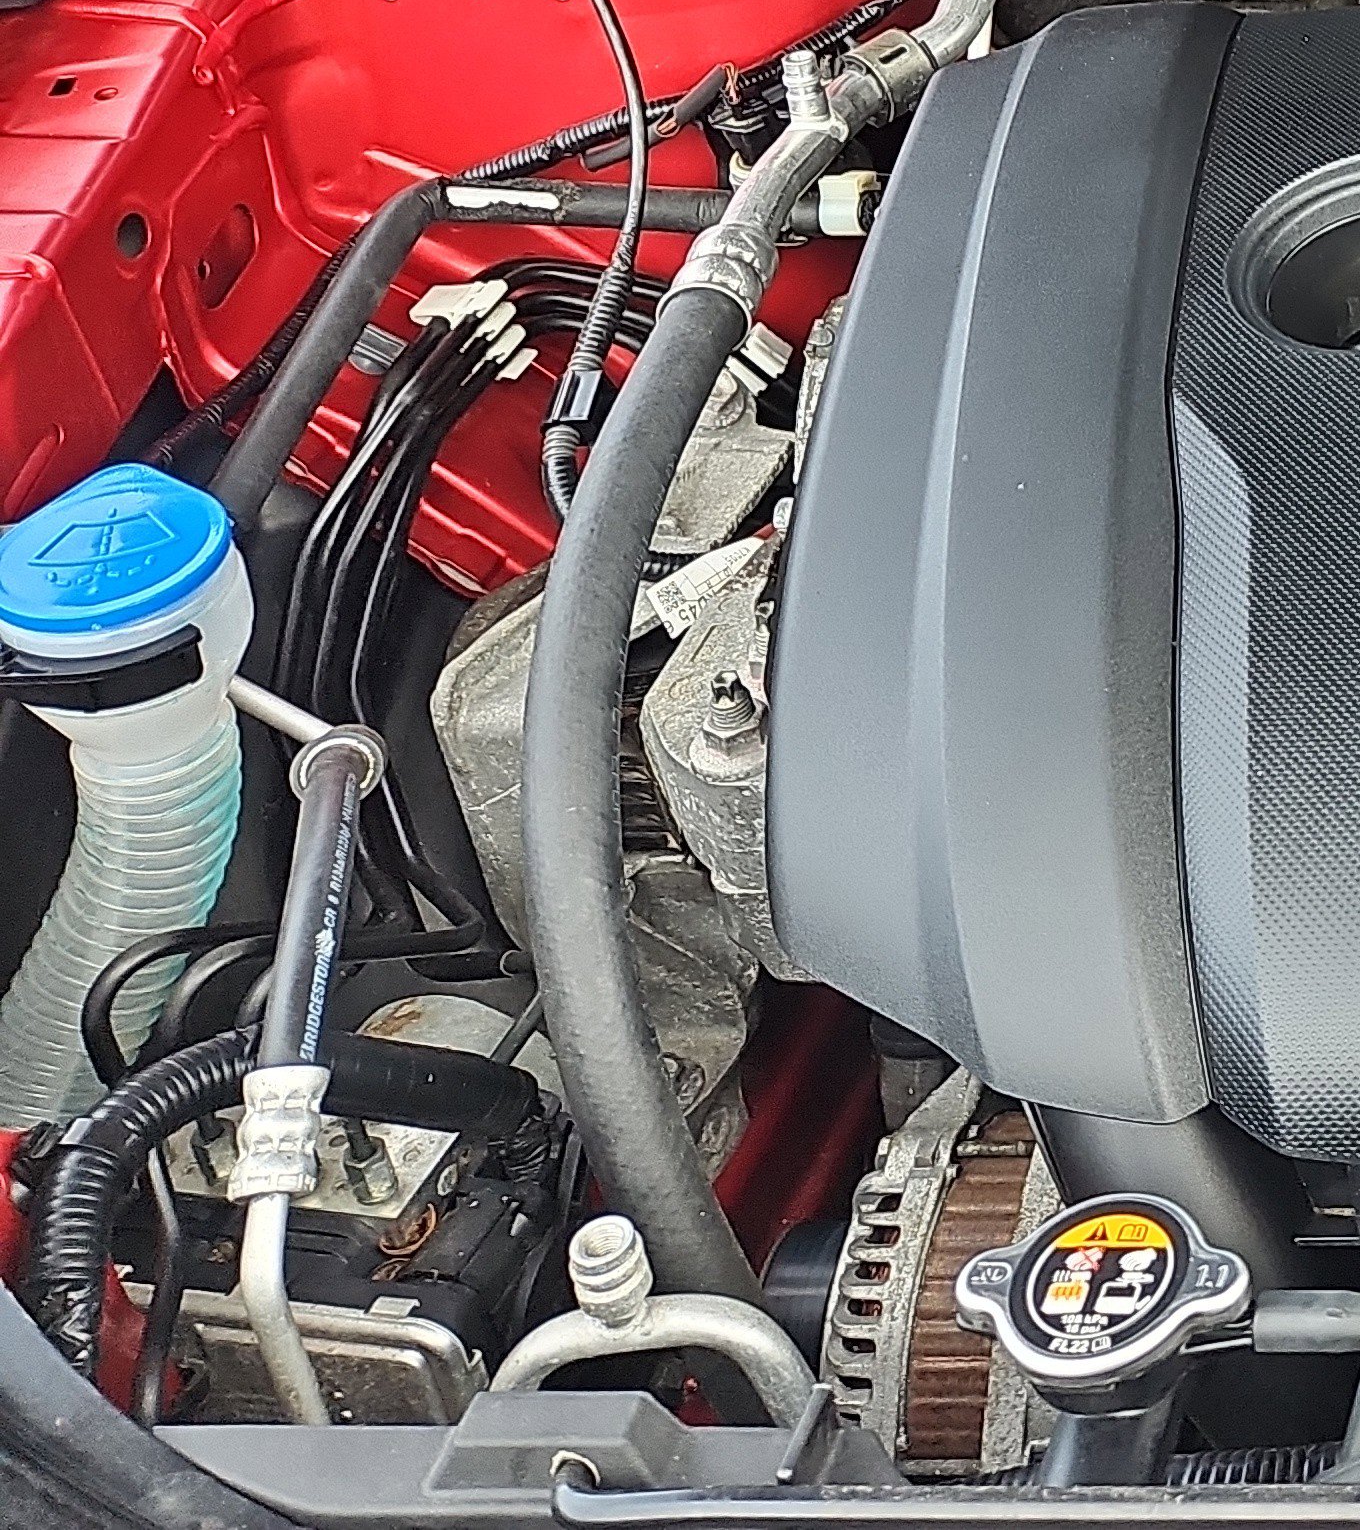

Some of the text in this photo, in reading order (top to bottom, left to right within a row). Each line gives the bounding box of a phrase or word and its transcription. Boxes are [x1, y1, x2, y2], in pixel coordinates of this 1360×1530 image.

[1195, 1264, 1230, 1288] 1.1
[1083, 1313, 1109, 1327] kPa
[1047, 1336, 1090, 1353] FL22
